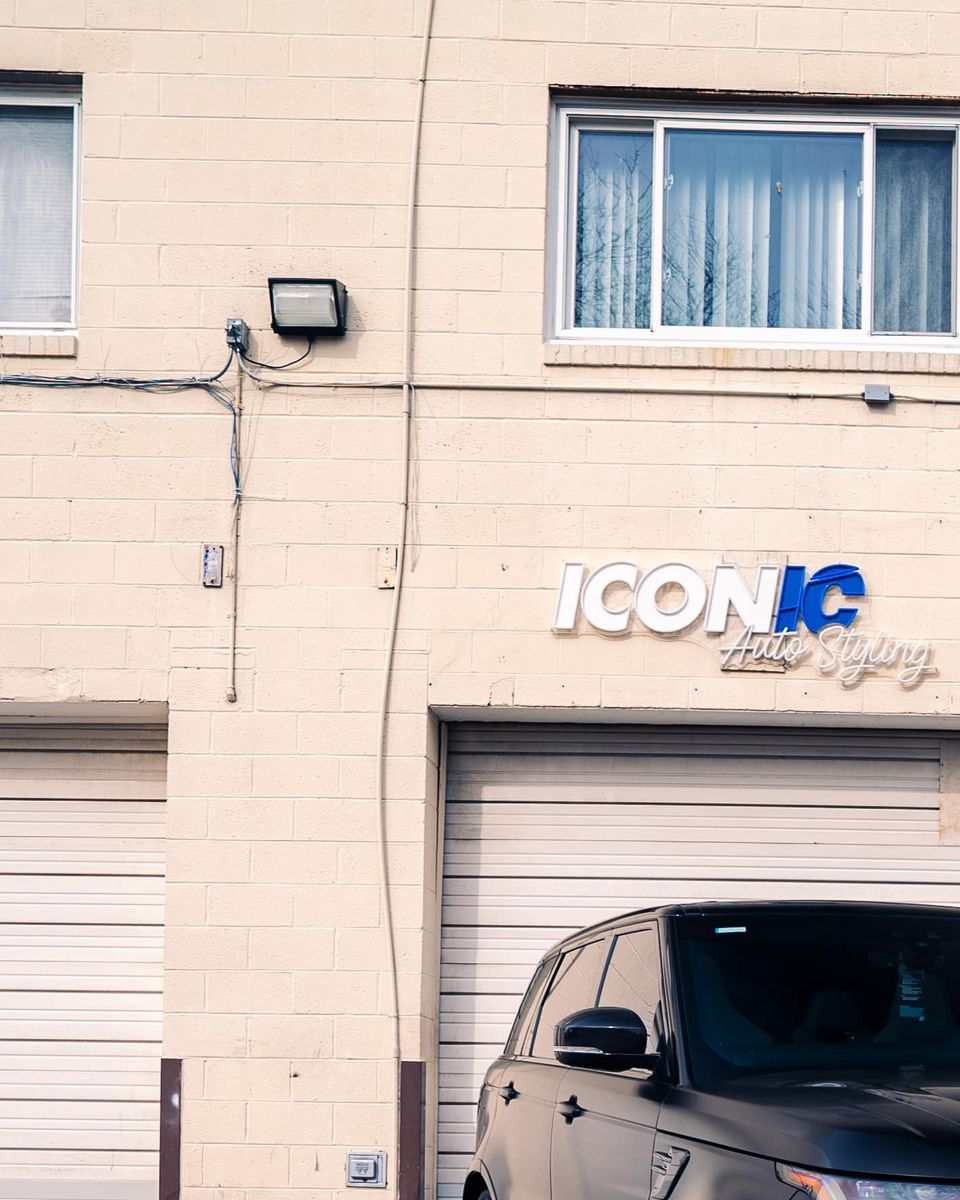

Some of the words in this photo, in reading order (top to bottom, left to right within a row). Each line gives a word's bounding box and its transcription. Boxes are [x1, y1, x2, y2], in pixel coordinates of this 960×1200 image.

[552, 562, 866, 634] ICONIC
[719, 625, 807, 667] Auto
[816, 625, 938, 686] Styling
